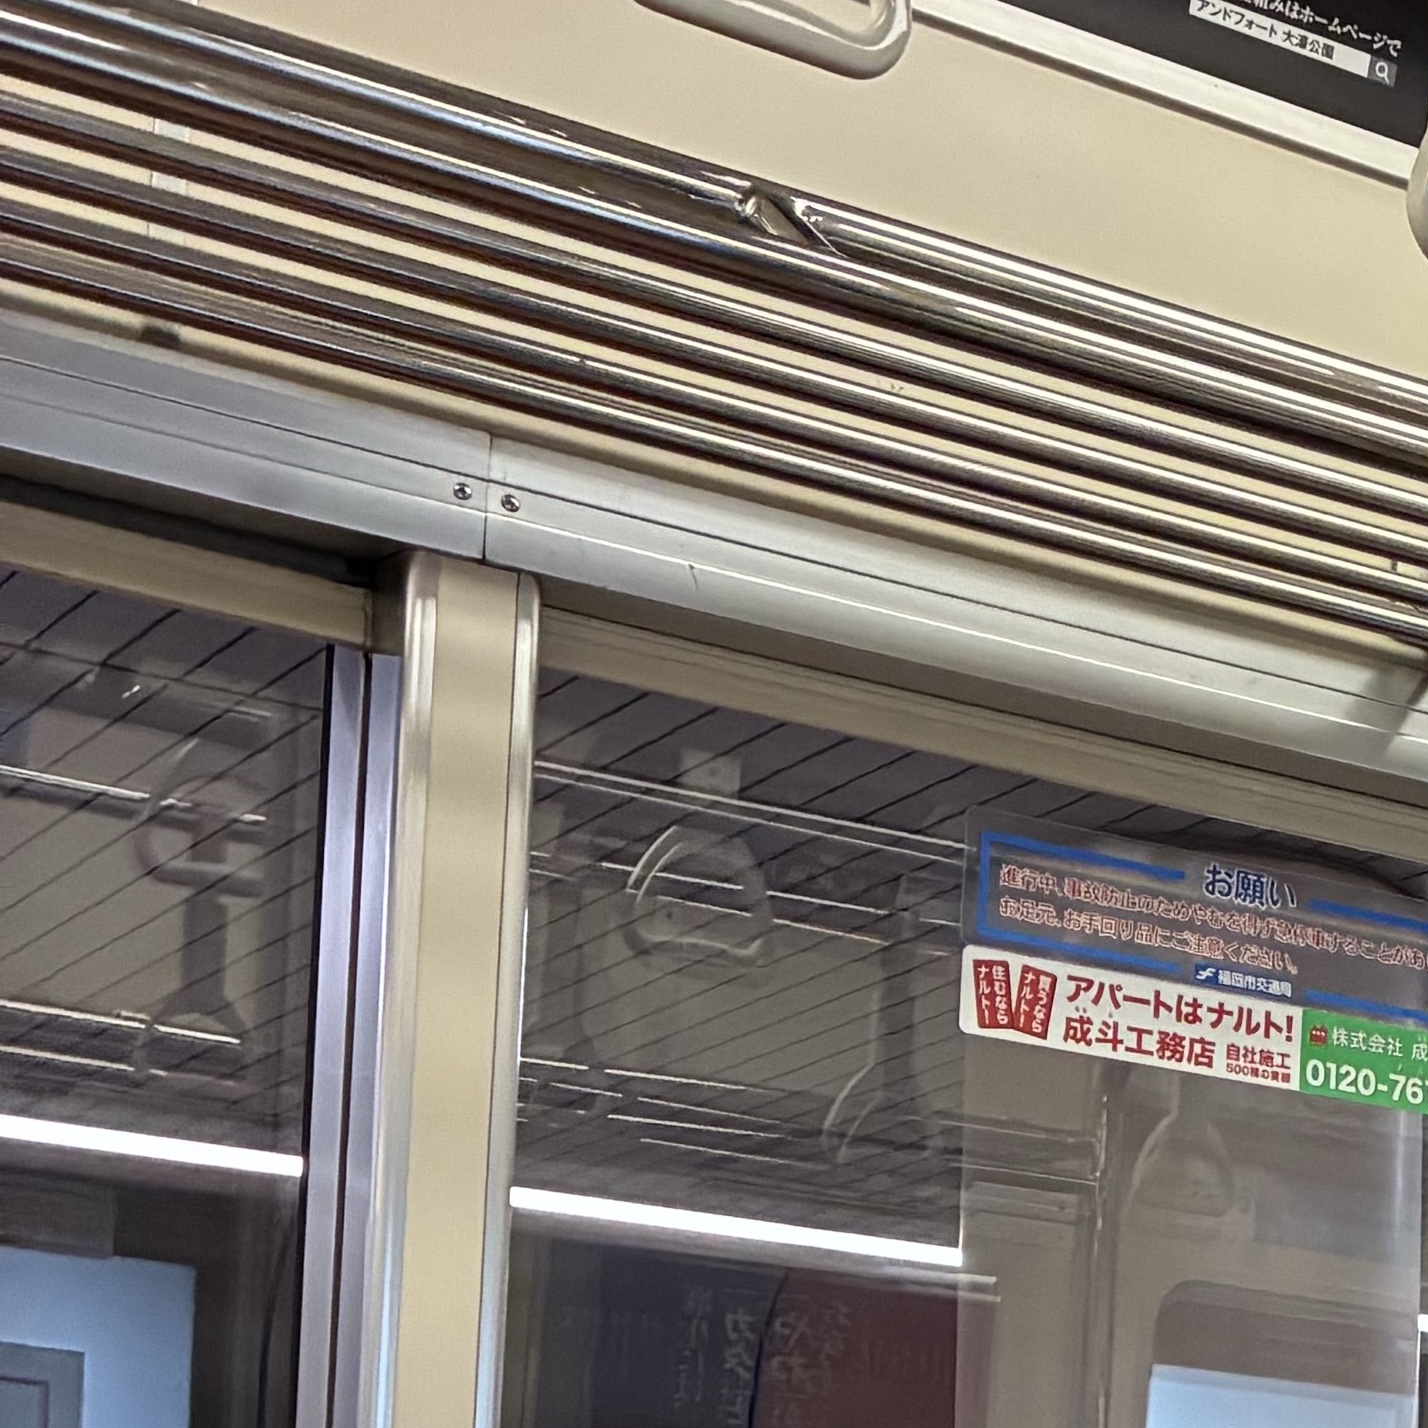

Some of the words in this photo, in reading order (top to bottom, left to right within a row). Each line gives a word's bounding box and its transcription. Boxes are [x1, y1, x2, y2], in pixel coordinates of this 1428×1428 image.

[1203, 862, 1298, 911] お願い
[991, 965, 1010, 1025] 住むなら
[1066, 974, 1294, 1042] アパートはナルト!
[1217, 969, 1292, 998] 福岡市交通局
[1062, 1014, 1217, 1069] 成斗工務店
[1225, 1042, 1292, 1070] 自社施工
[1332, 1026, 1404, 1058] 株式会社
